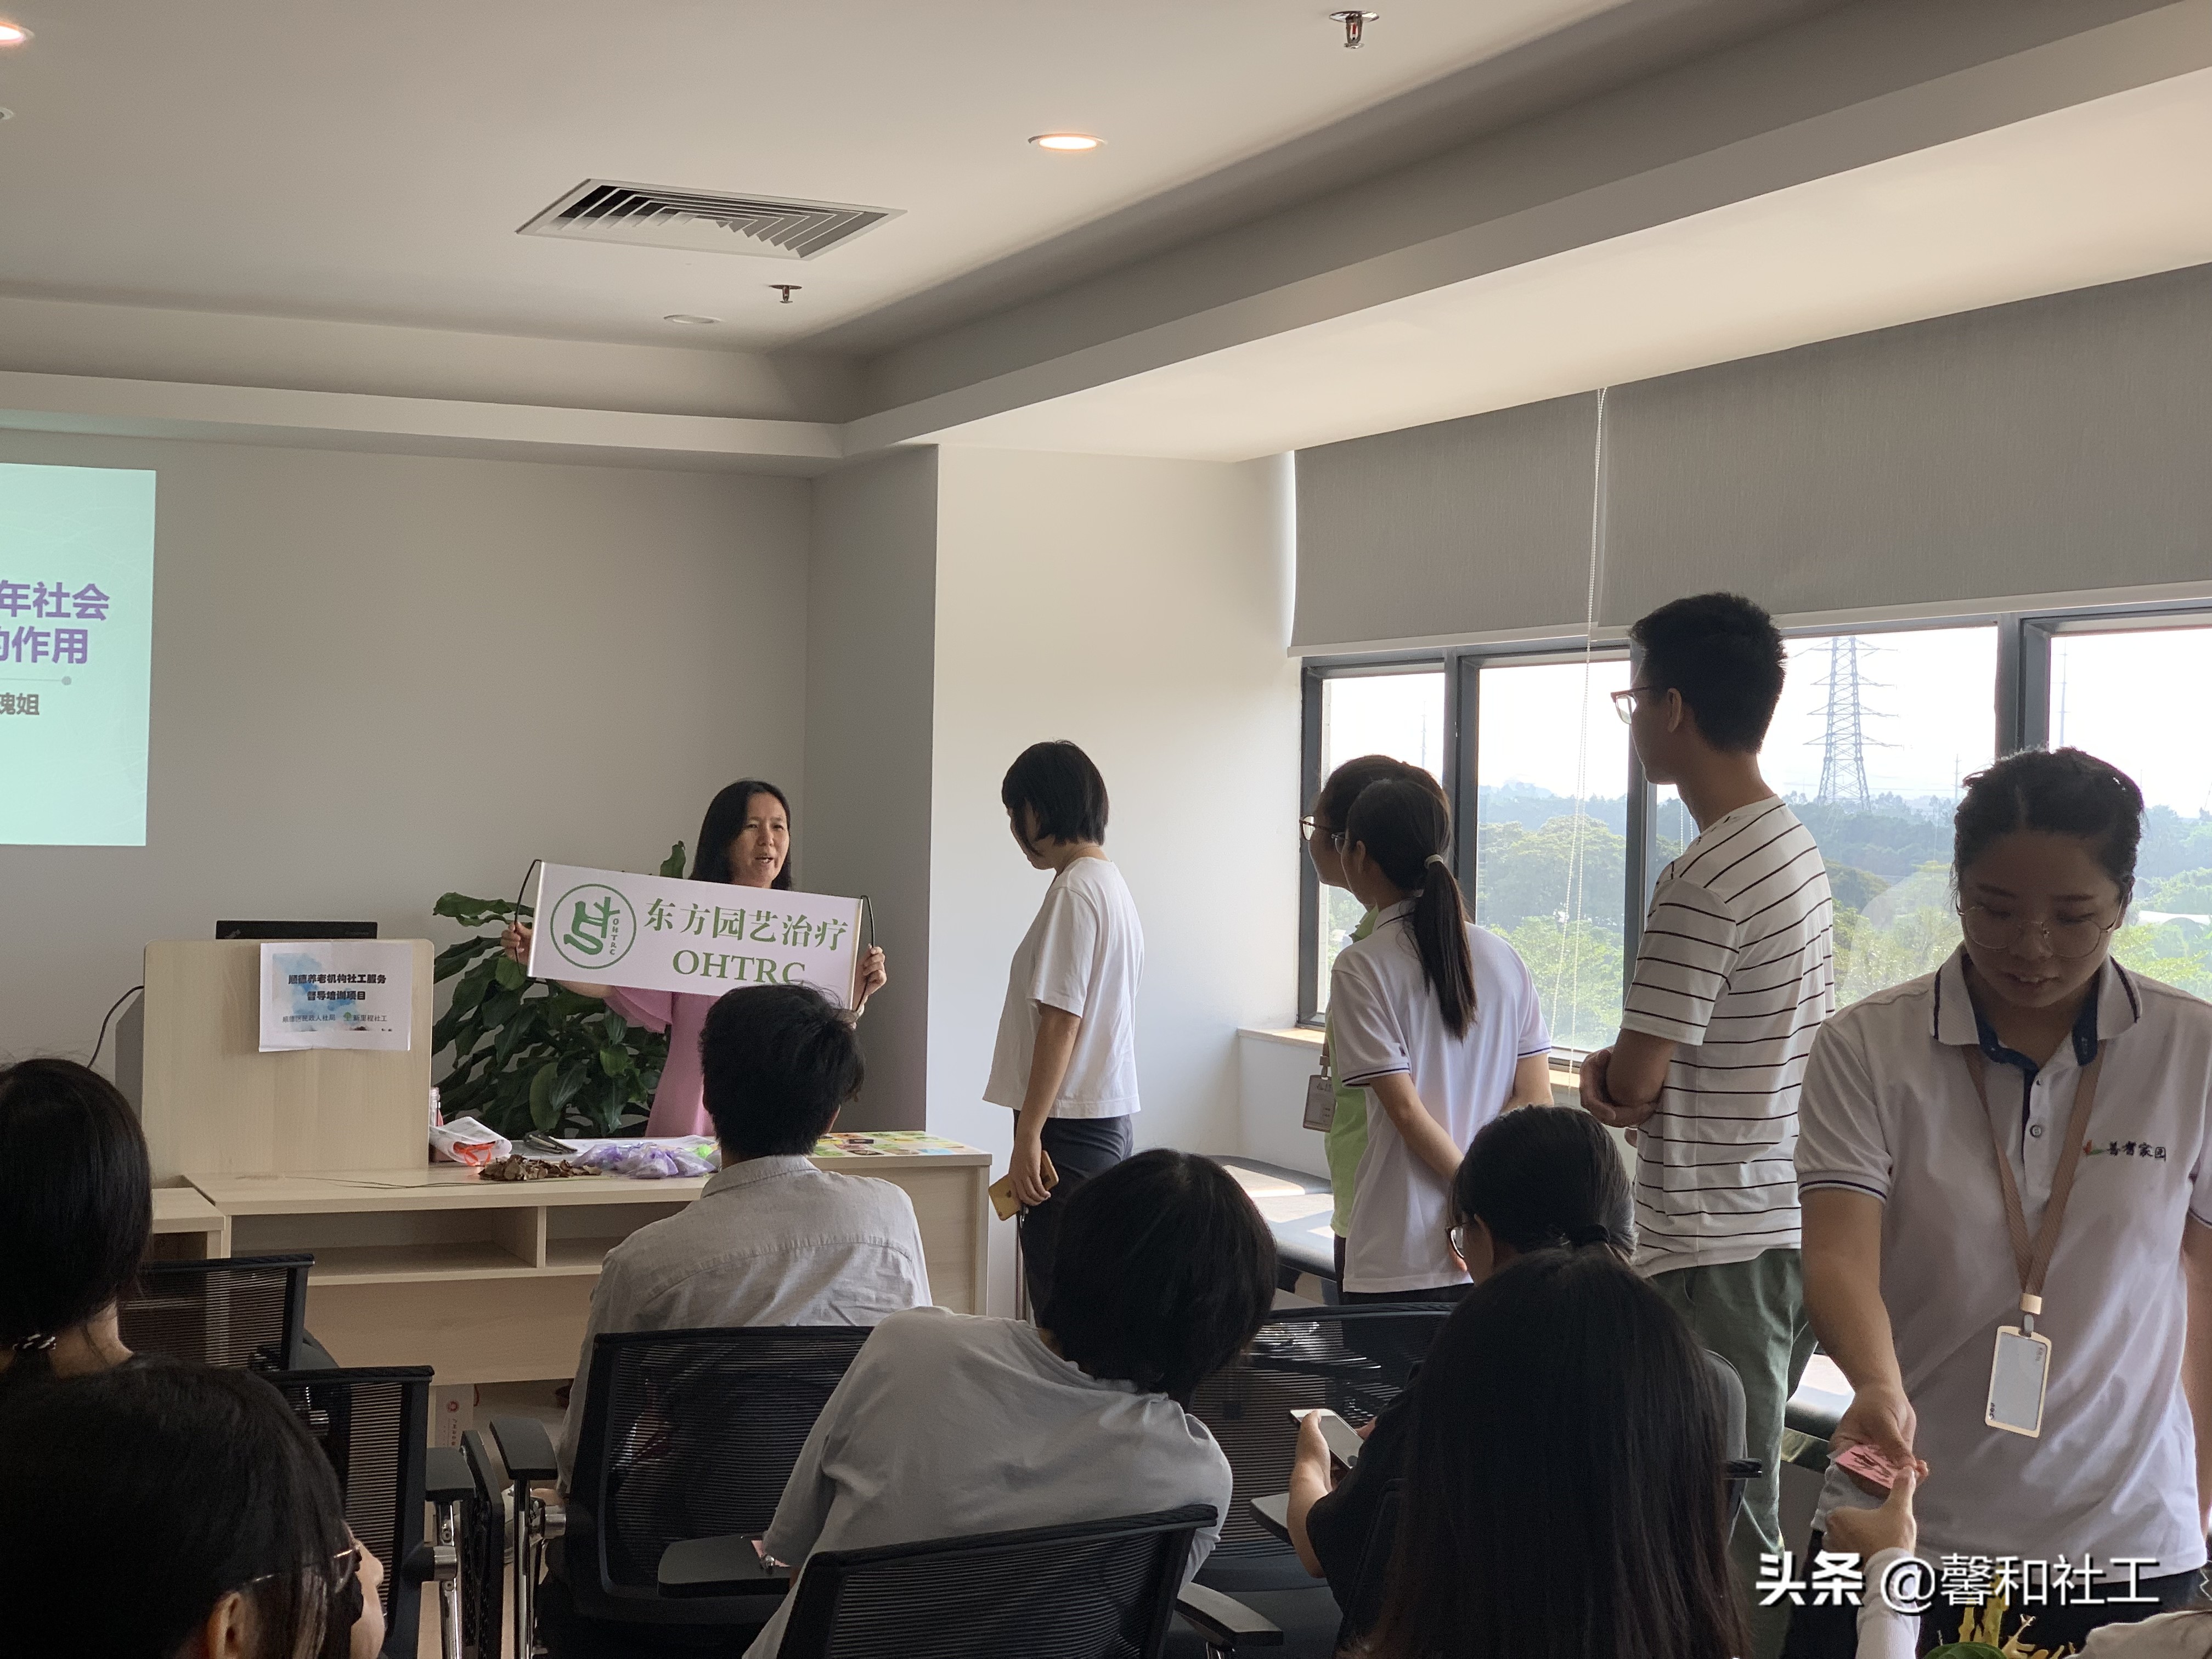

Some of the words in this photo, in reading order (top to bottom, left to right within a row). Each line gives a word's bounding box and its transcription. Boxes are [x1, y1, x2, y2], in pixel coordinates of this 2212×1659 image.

[0, 580, 110, 620] 年社会
[610, 918, 619, 955] OHTRC
[644, 898, 848, 951] 东方园艺治疗
[288, 974, 386, 984] 顺德养老机构社工服务
[307, 991, 366, 1001] 督导培训项目
